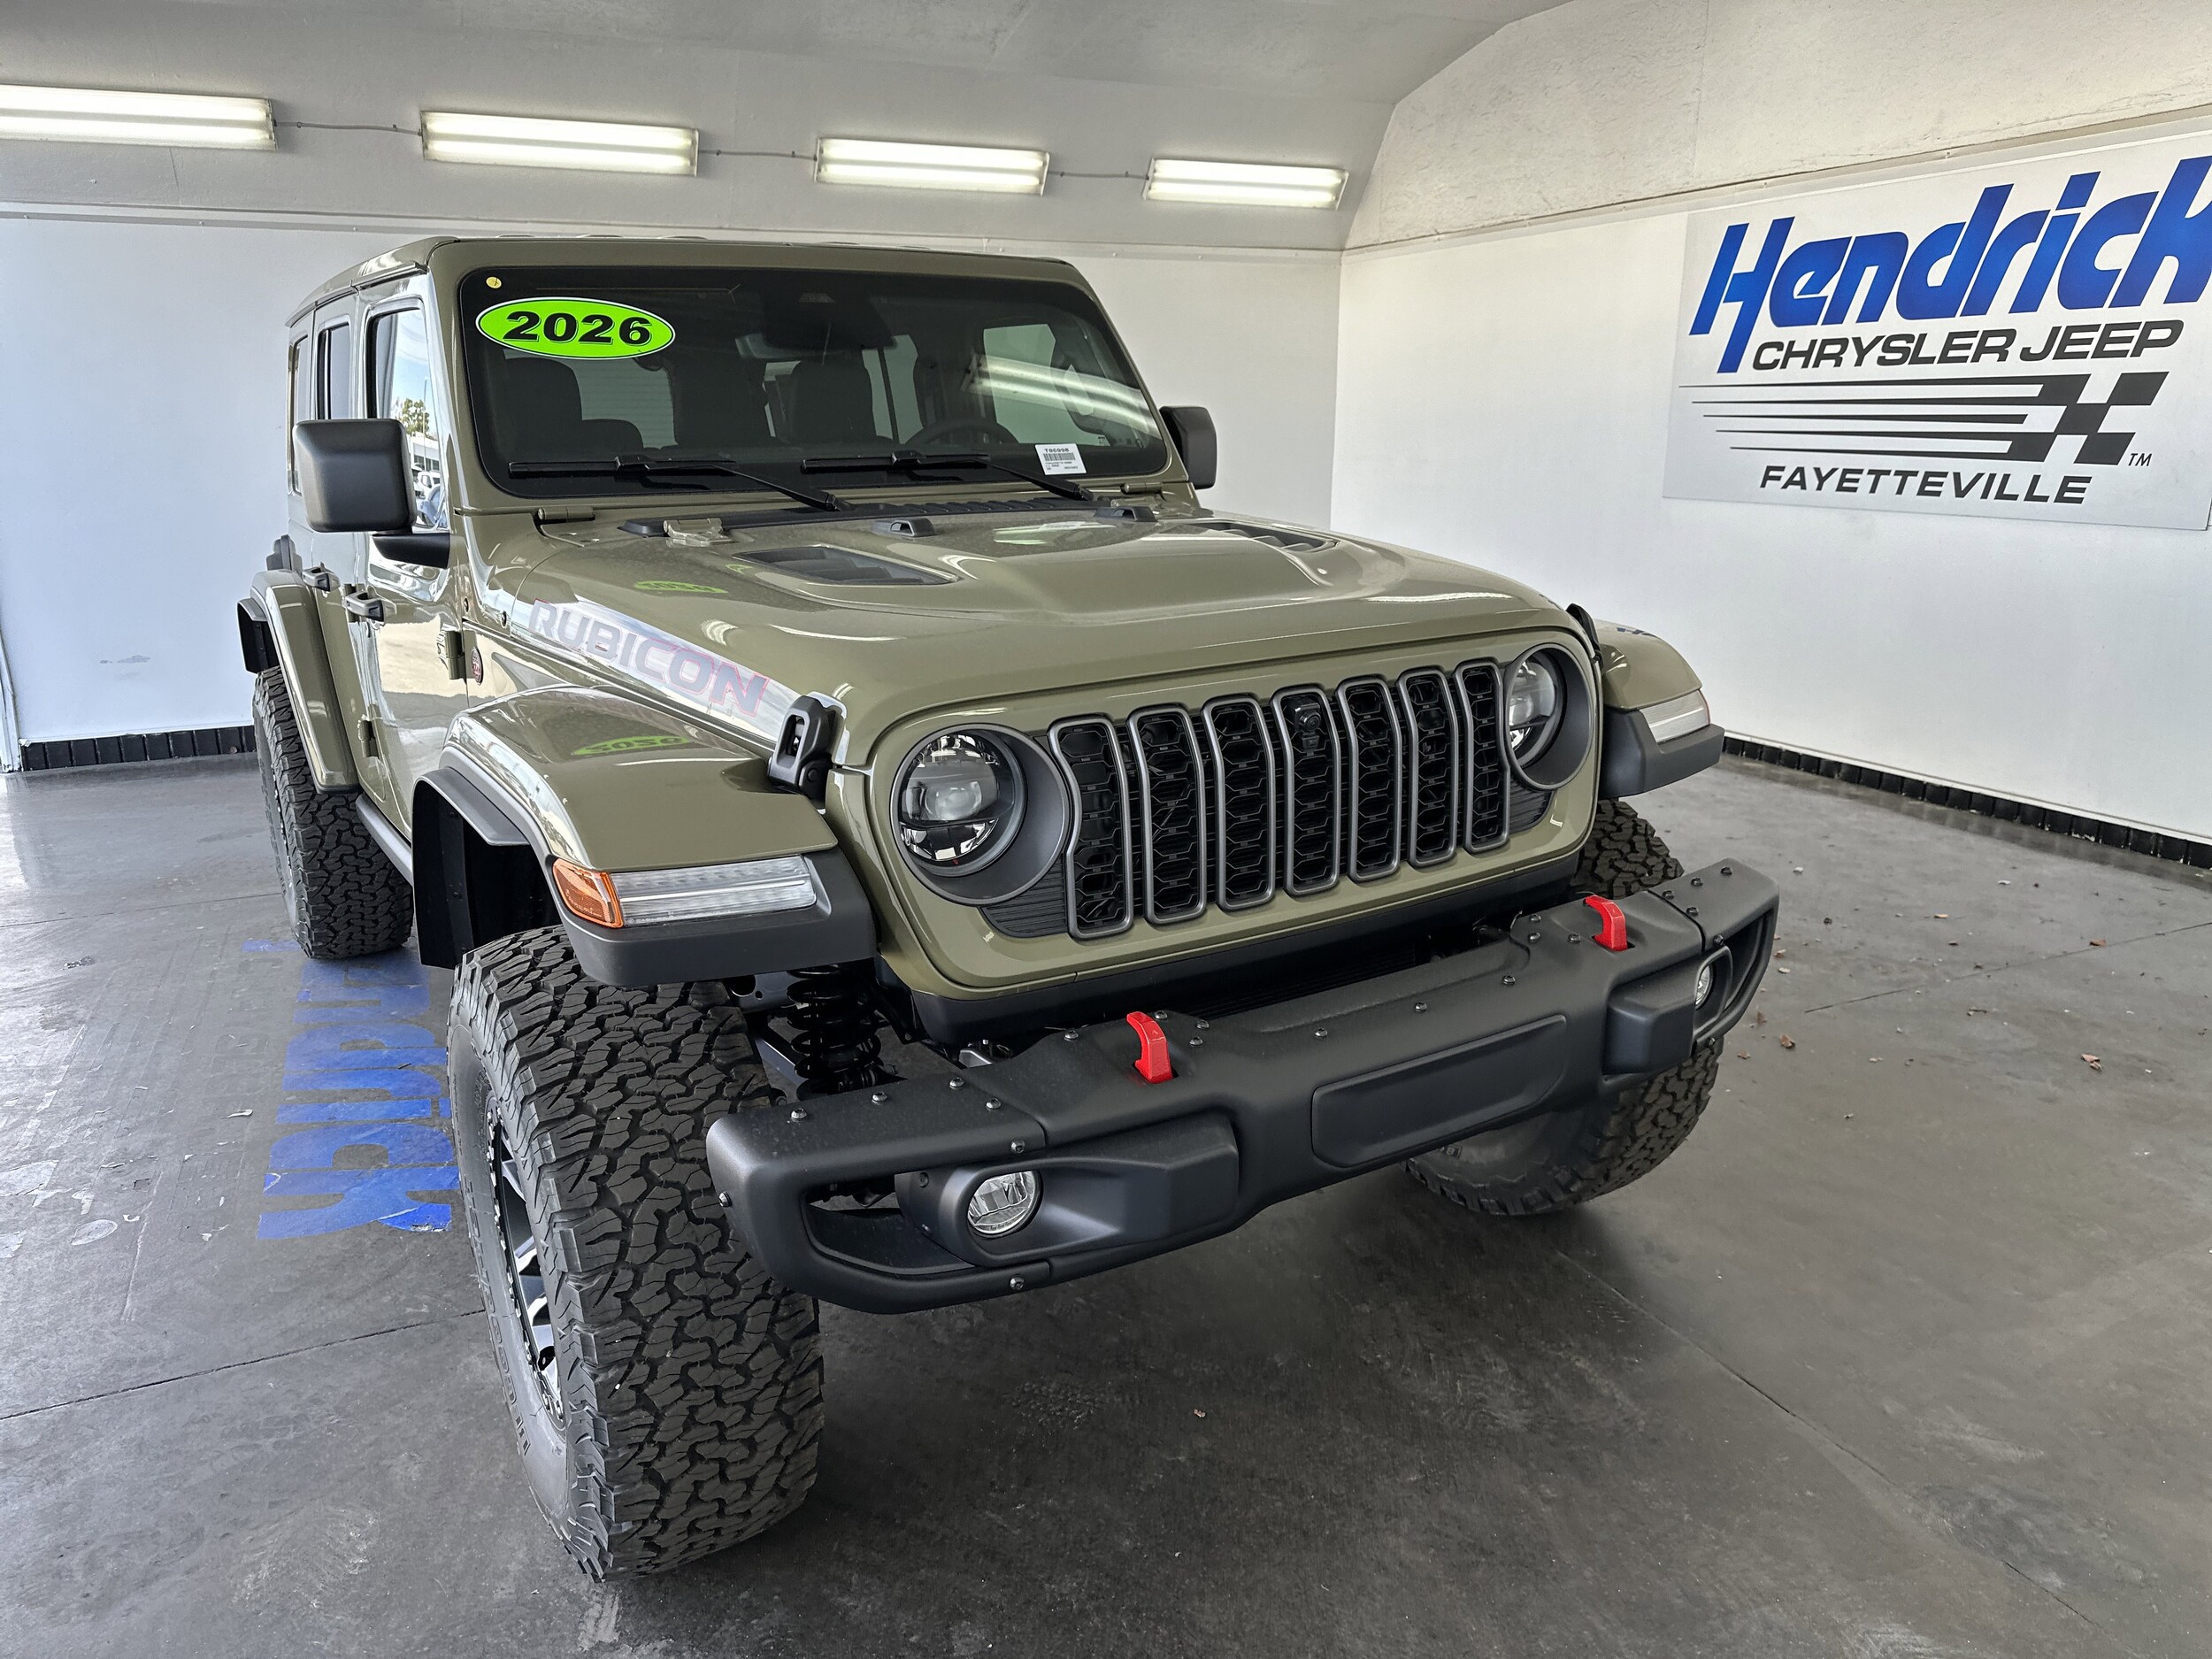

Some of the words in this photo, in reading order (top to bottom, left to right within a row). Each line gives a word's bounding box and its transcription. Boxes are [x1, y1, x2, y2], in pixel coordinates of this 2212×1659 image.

[1689, 156, 2212, 373] Hendrick
[503, 311, 652, 345] 2026
[1752, 329, 2016, 370] CHRYSLER
[2021, 320, 2185, 361] JEEP
[1759, 465, 2092, 504] FAYETTEVILLE
[2128, 452, 2152, 467] TM
[528, 599, 771, 717] RUBICON
[242, 939, 461, 1240] endrick
